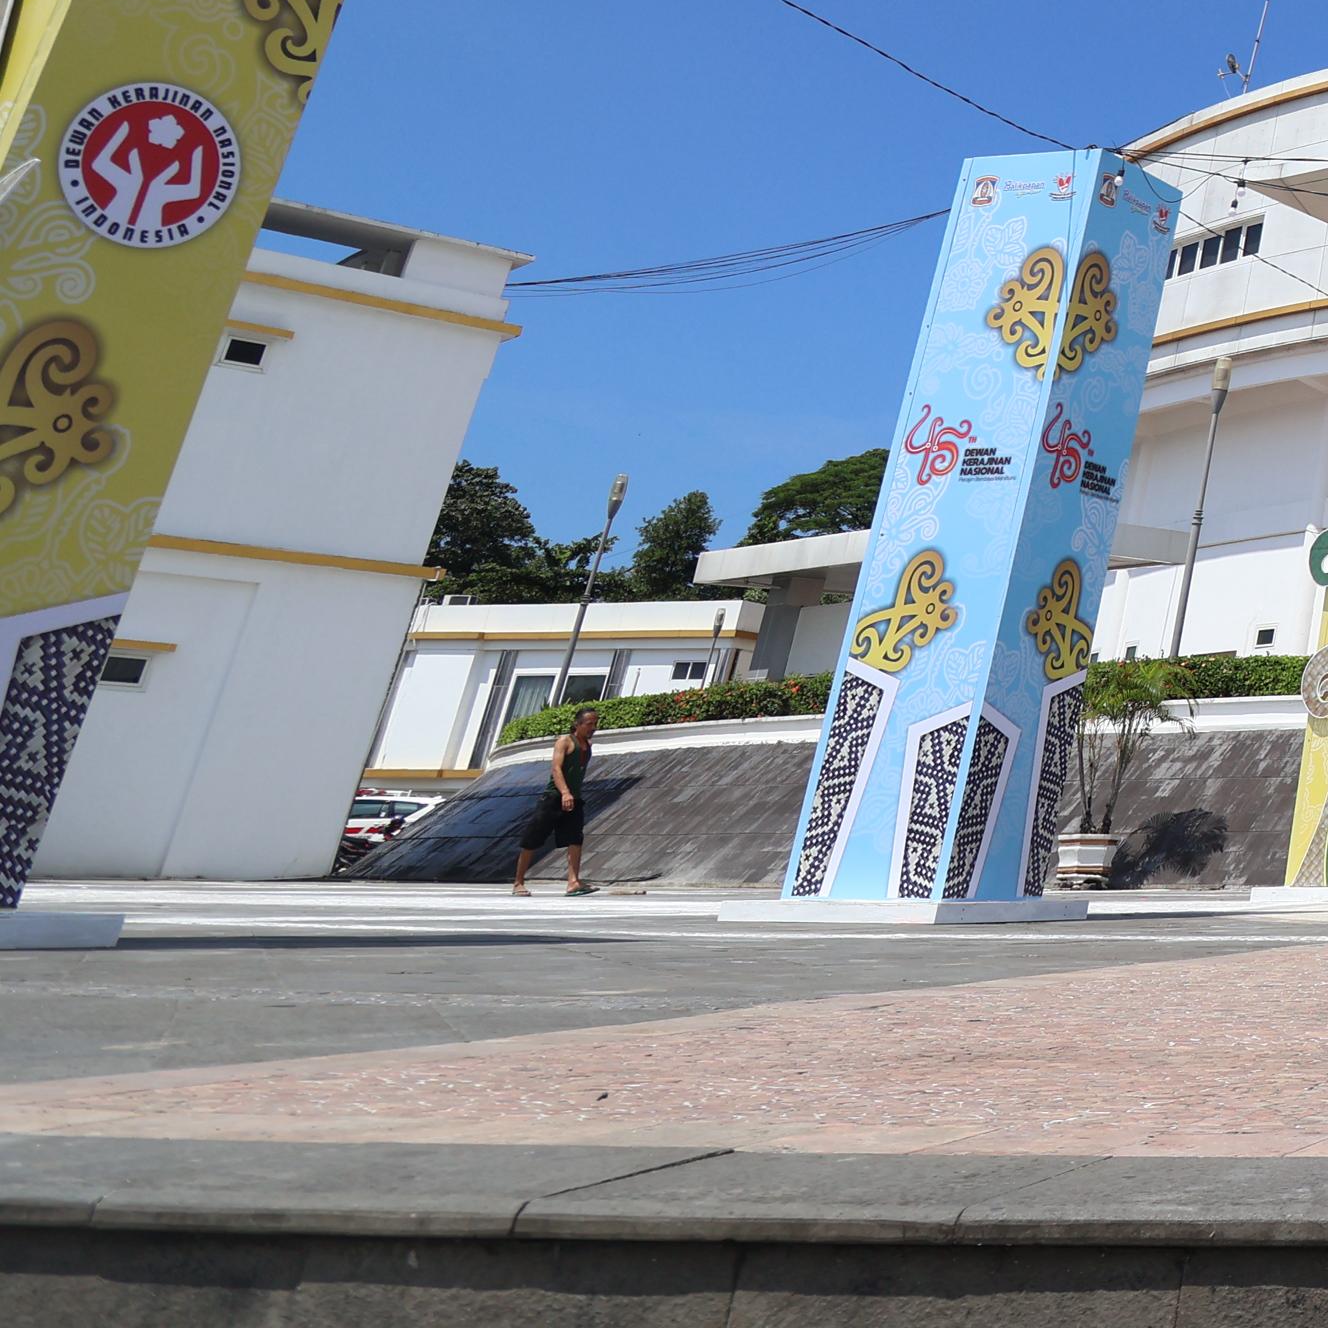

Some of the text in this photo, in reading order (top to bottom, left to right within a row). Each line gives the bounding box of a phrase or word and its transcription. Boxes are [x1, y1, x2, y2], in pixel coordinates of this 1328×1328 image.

[64, 86, 236, 211] DEWAN KERAJINAN NASIONAL
[75, 196, 190, 244] INDONESIA
[964, 448, 997, 457] DEWAN
[962, 457, 1012, 466] KERAJINAN
[960, 467, 1005, 477] NASIONAL
